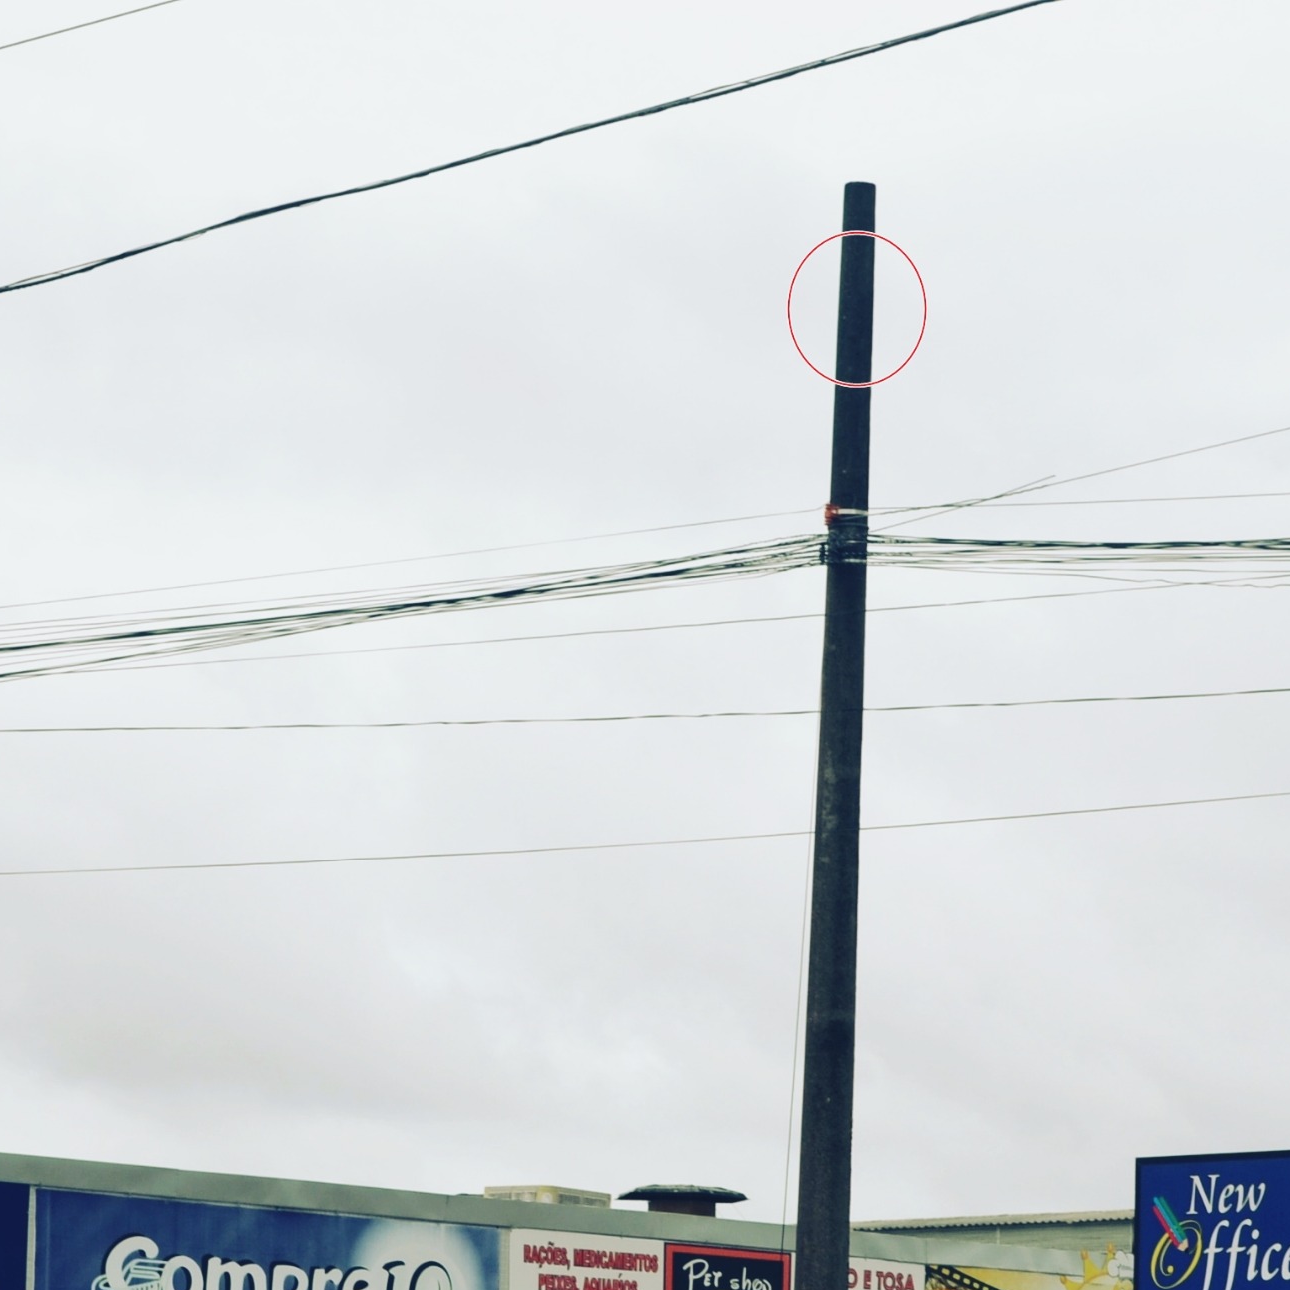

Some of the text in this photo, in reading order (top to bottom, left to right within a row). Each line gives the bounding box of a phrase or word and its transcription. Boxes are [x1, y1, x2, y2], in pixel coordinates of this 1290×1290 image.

[1186, 1174, 1266, 1215] New
[524, 1242, 658, 1273] RAÇÕES, MEDICAMENTOS
[864, 1270, 871, 1290] E
